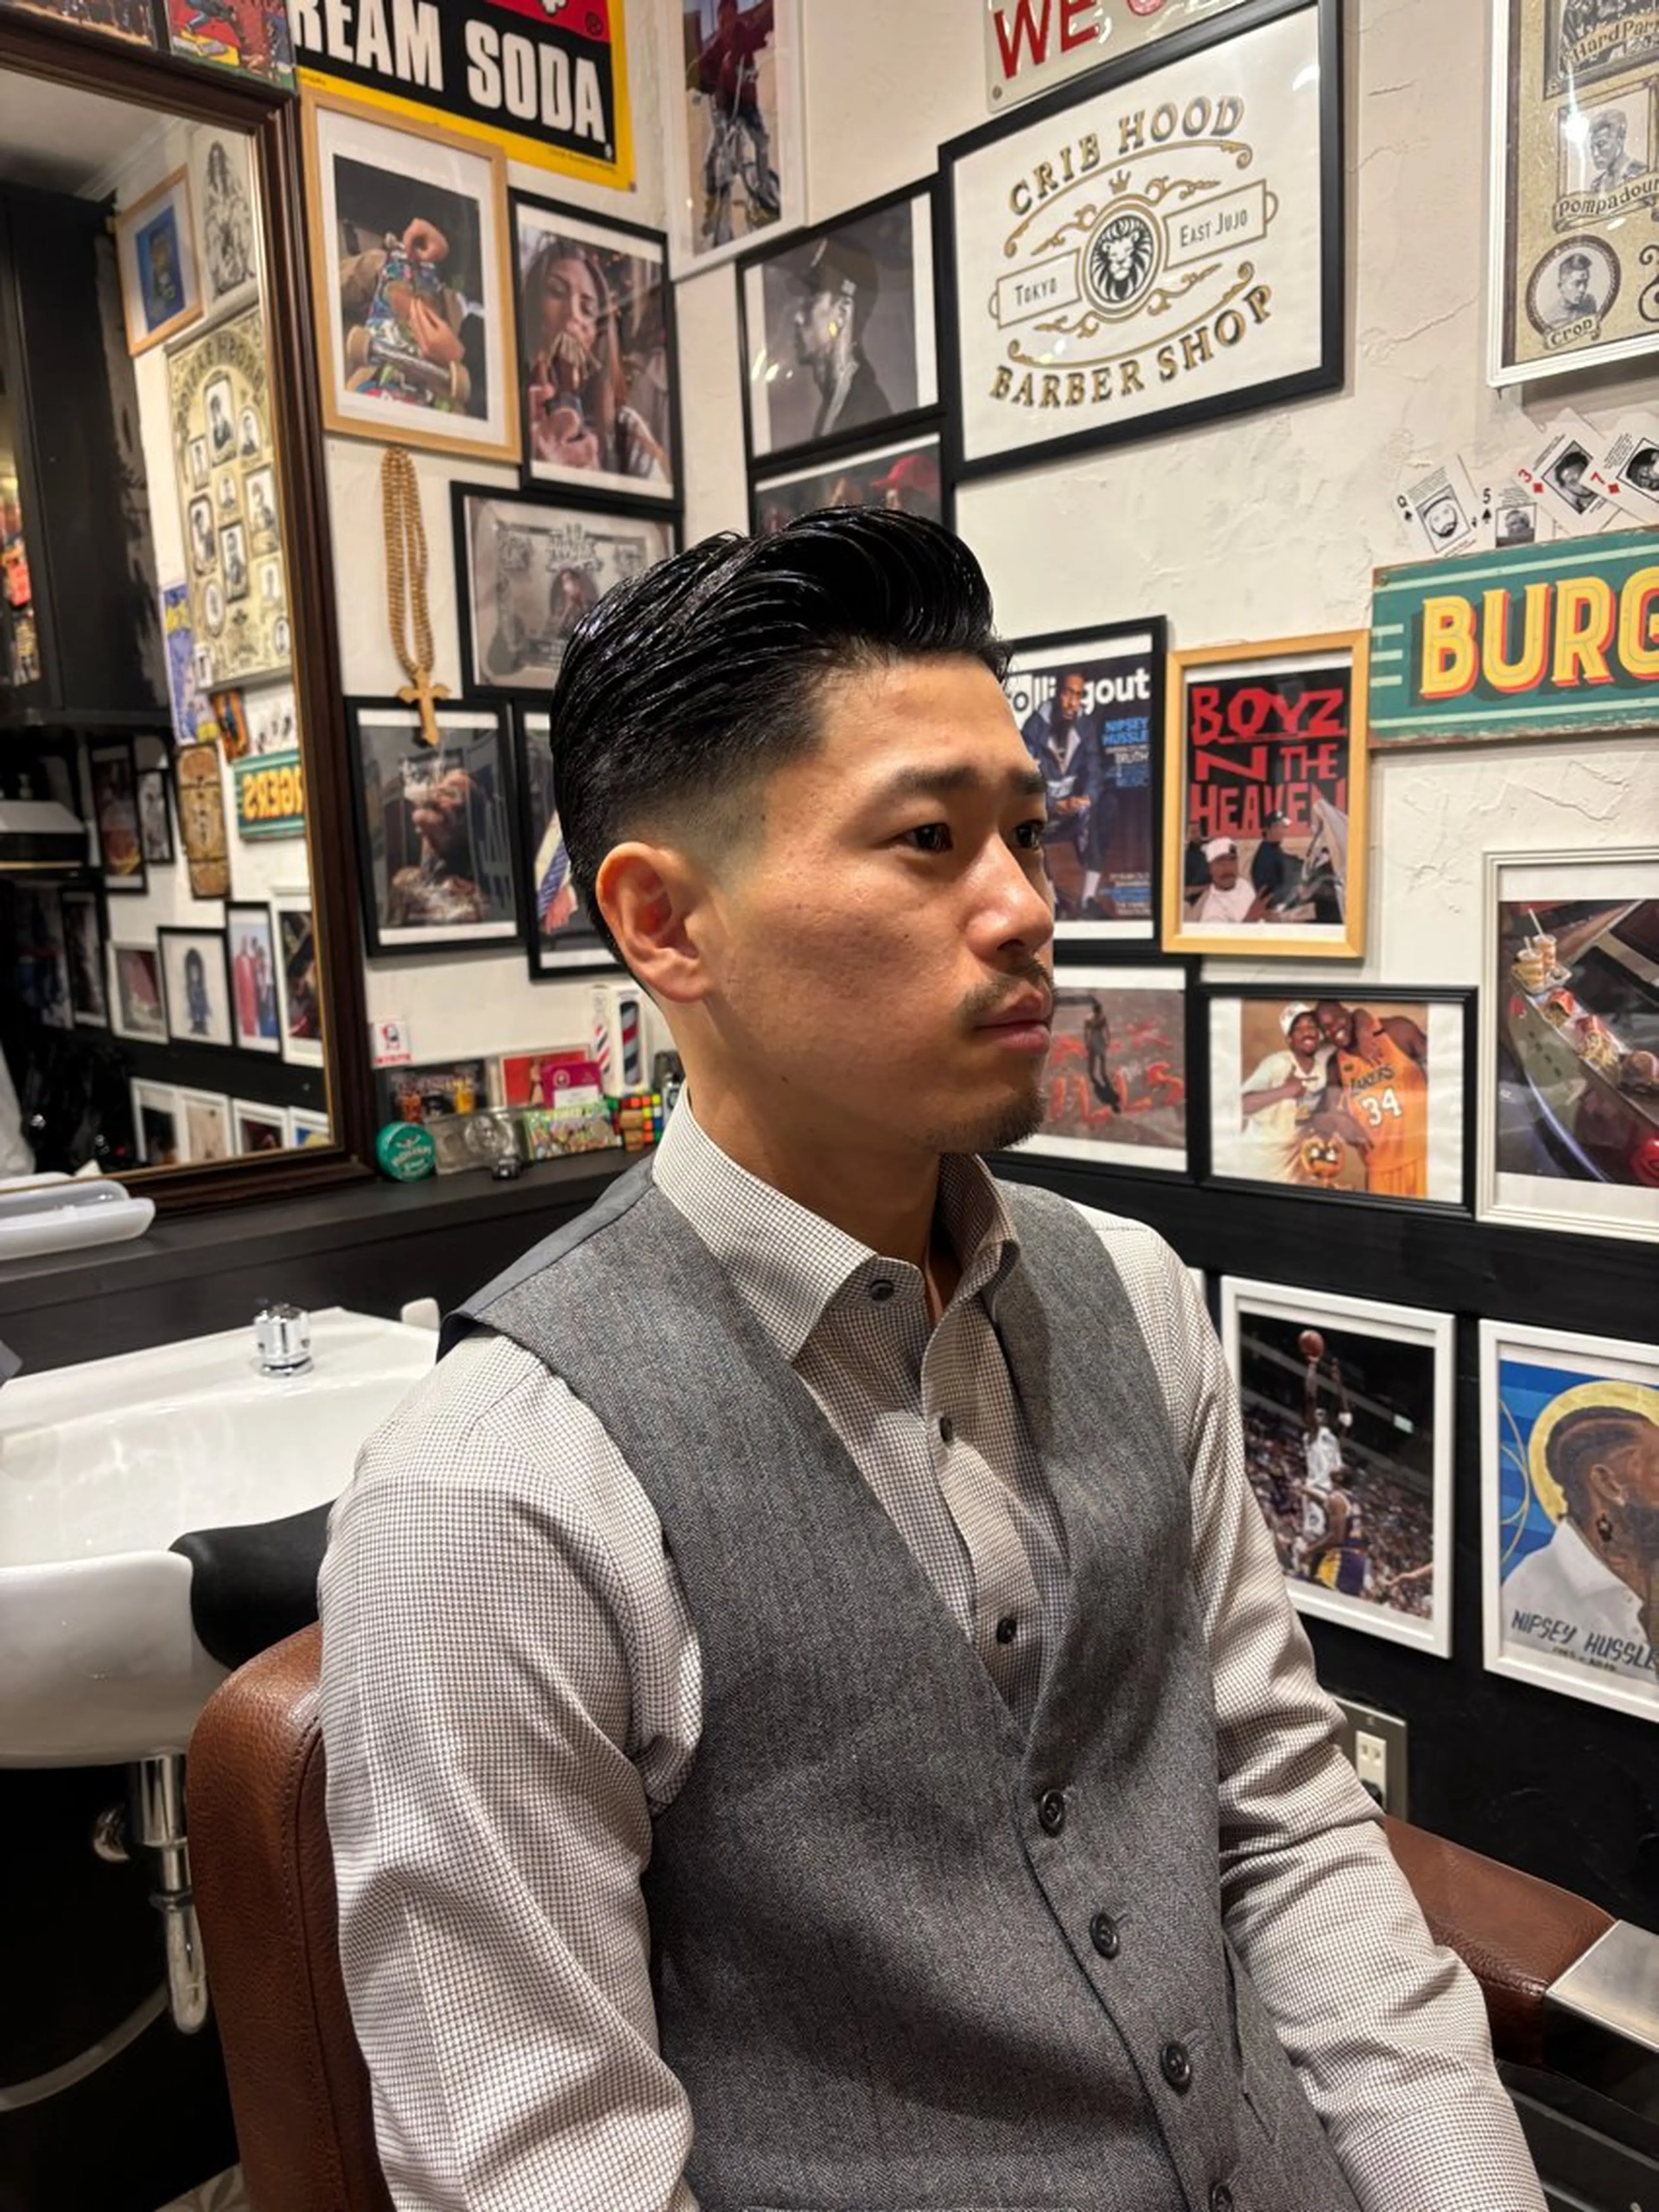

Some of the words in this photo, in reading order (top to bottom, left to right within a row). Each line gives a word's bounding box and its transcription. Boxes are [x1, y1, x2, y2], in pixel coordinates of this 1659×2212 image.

[994, 0, 1100, 79] WE
[1573, 24, 1619, 61] Hard
[465, 19, 606, 143] SODA
[1118, 95, 1245, 154] HOOD
[990, 359, 1145, 408] BARBER
[1157, 285, 1272, 382] SHOP
[1192, 686, 1344, 747] BOYZ
[1195, 746, 1268, 781] N
[1281, 744, 1338, 779] THE
[1362, 1087, 1403, 1127] 34
[1512, 1609, 1577, 1644] NIPSEY
